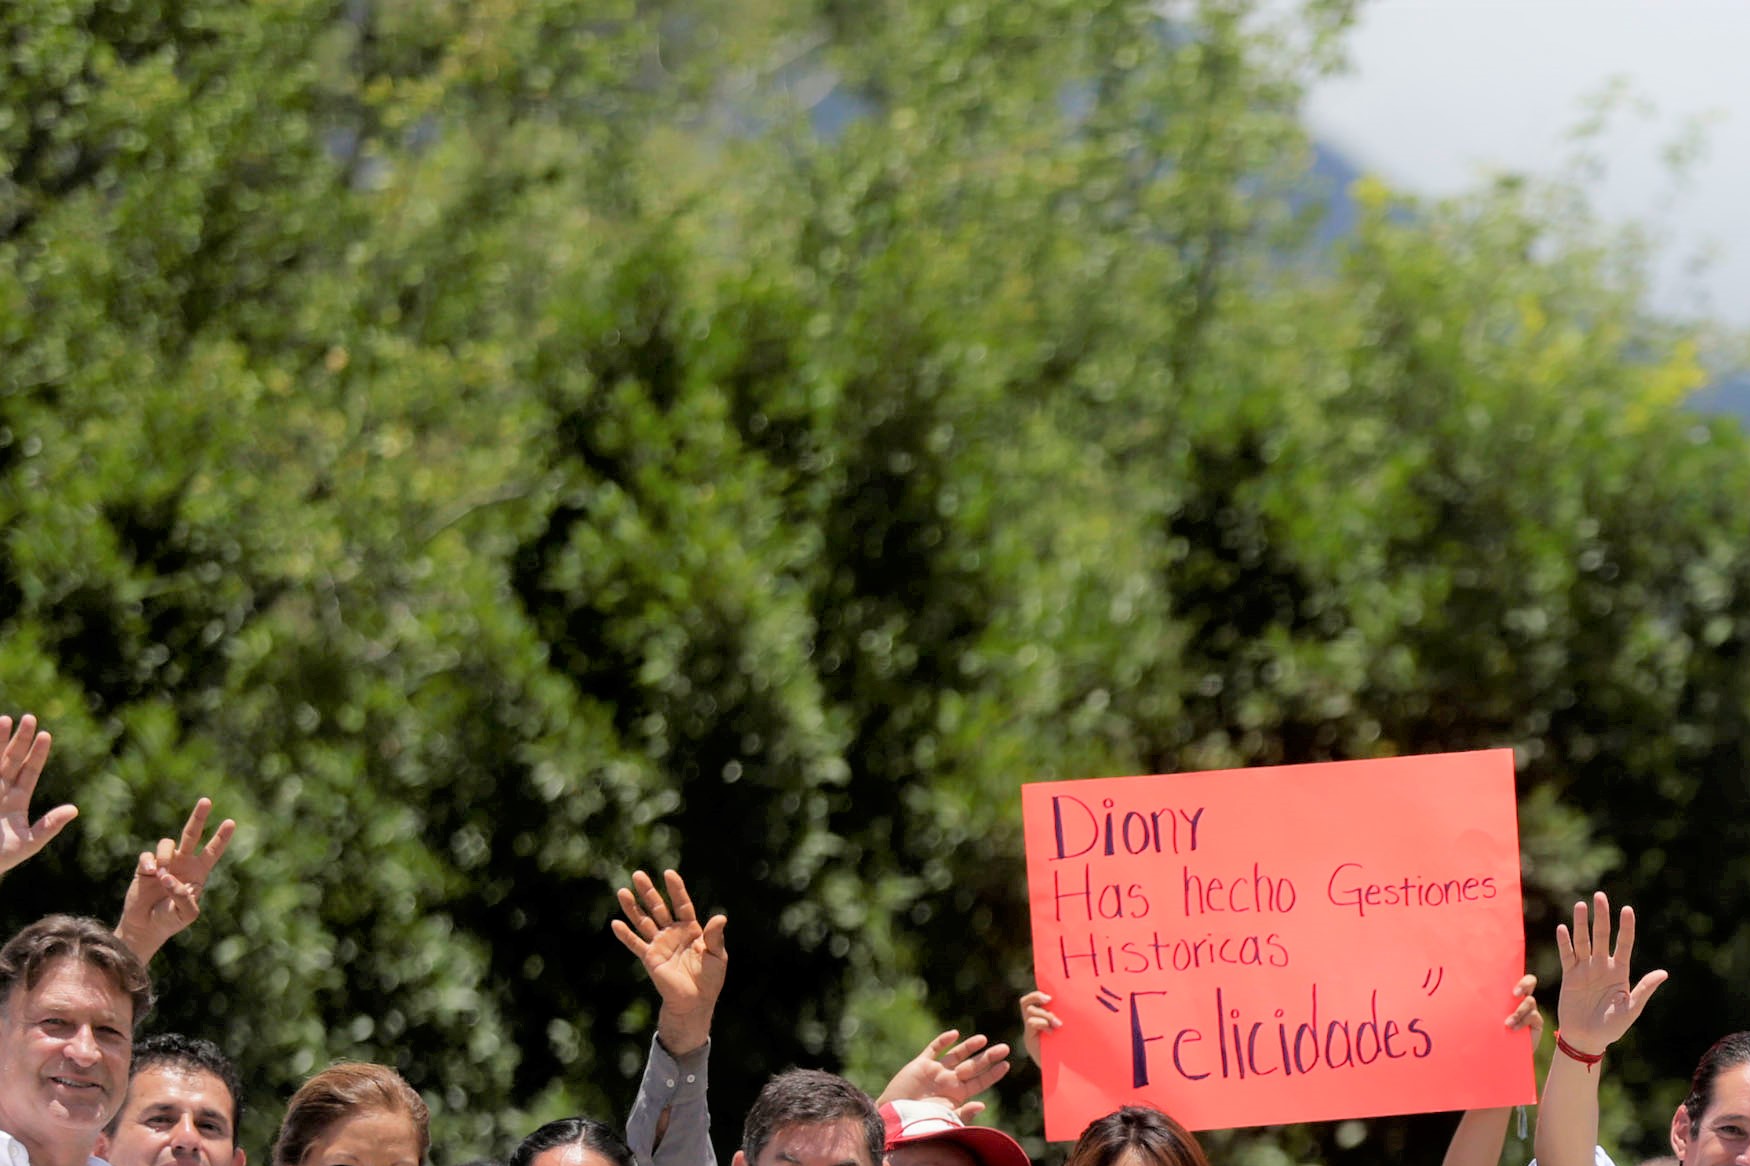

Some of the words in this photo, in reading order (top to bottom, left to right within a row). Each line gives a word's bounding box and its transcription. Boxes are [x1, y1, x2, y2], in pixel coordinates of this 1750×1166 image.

[1054, 863, 1150, 922] Has
[1184, 862, 1297, 917] hecho
[1328, 863, 1497, 917] Gestiones
[1060, 932, 1289, 979] Historicas
